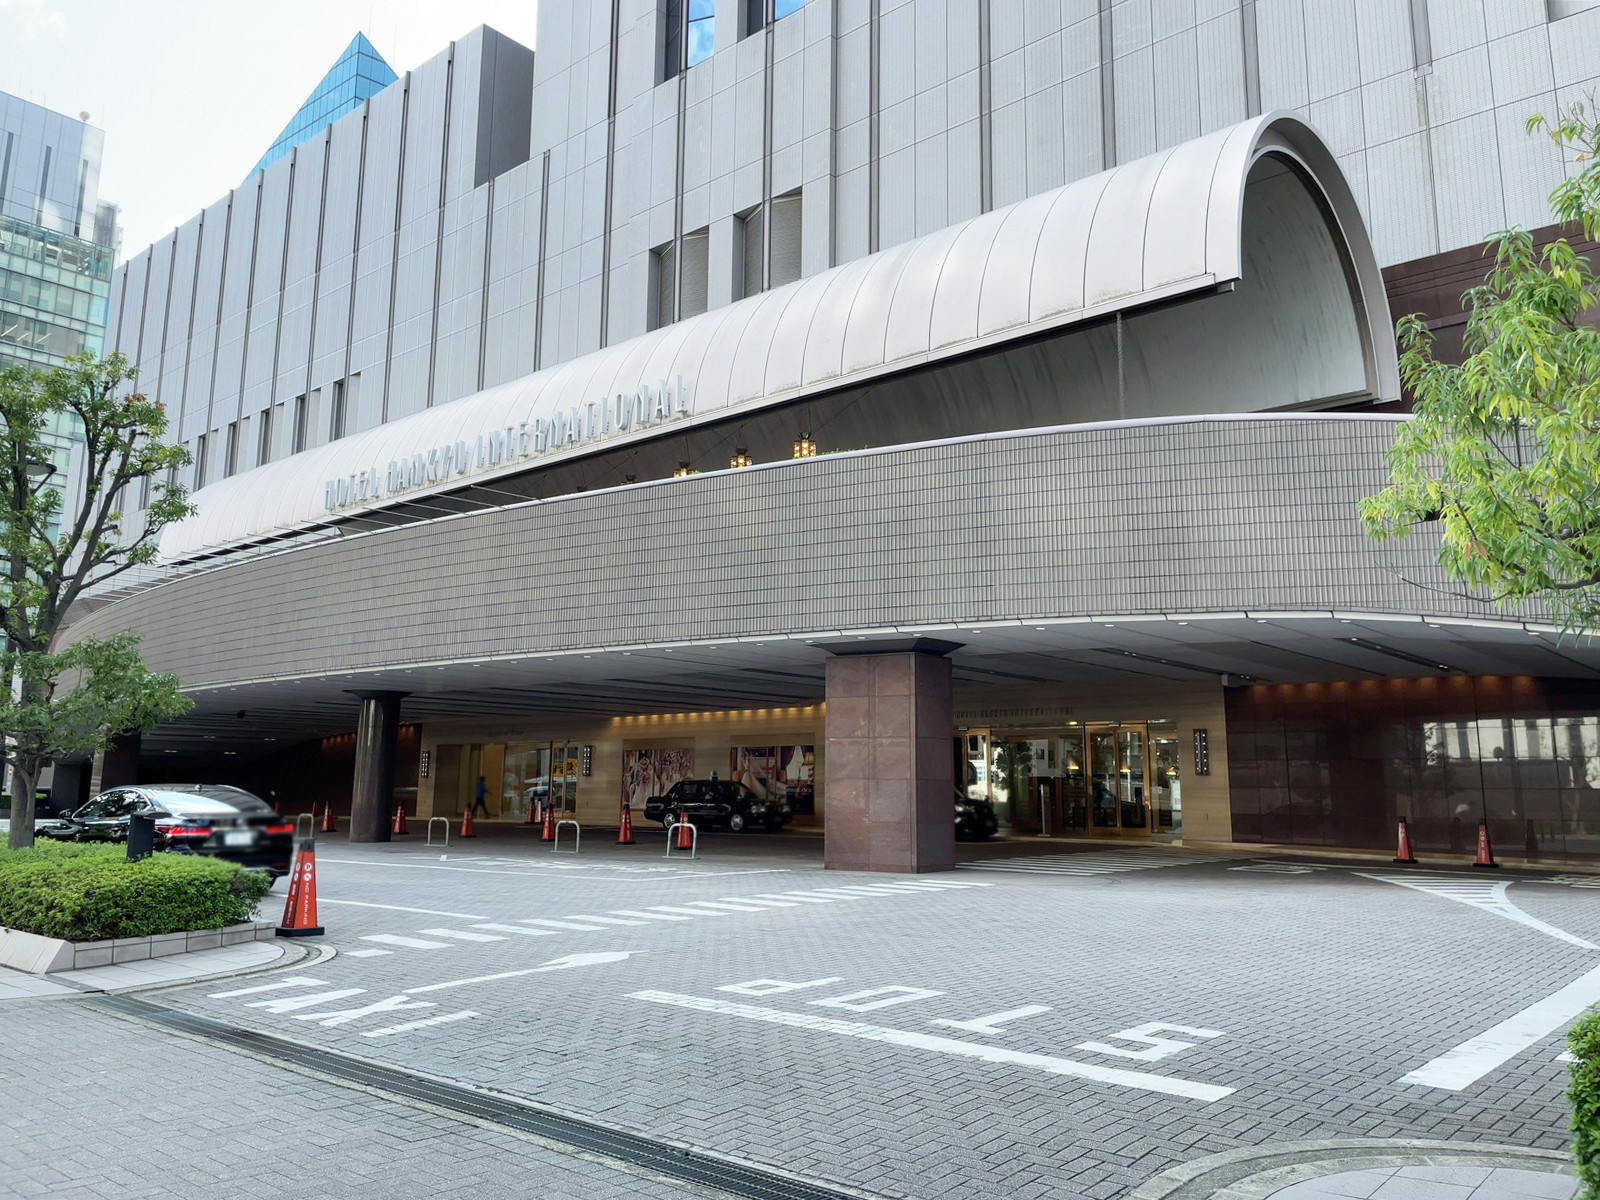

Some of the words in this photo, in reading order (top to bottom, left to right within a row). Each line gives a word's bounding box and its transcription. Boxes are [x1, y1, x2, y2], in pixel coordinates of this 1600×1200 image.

[325, 467, 379, 510] HOTEL
[387, 440, 467, 493] HANKYU
[475, 374, 688, 469] INTERNATIONAL
[302, 894, 310, 925] PARKING
[304, 882, 310, 893] NO
[207, 976, 482, 1038] TAXI
[712, 976, 1227, 1062] STOP
